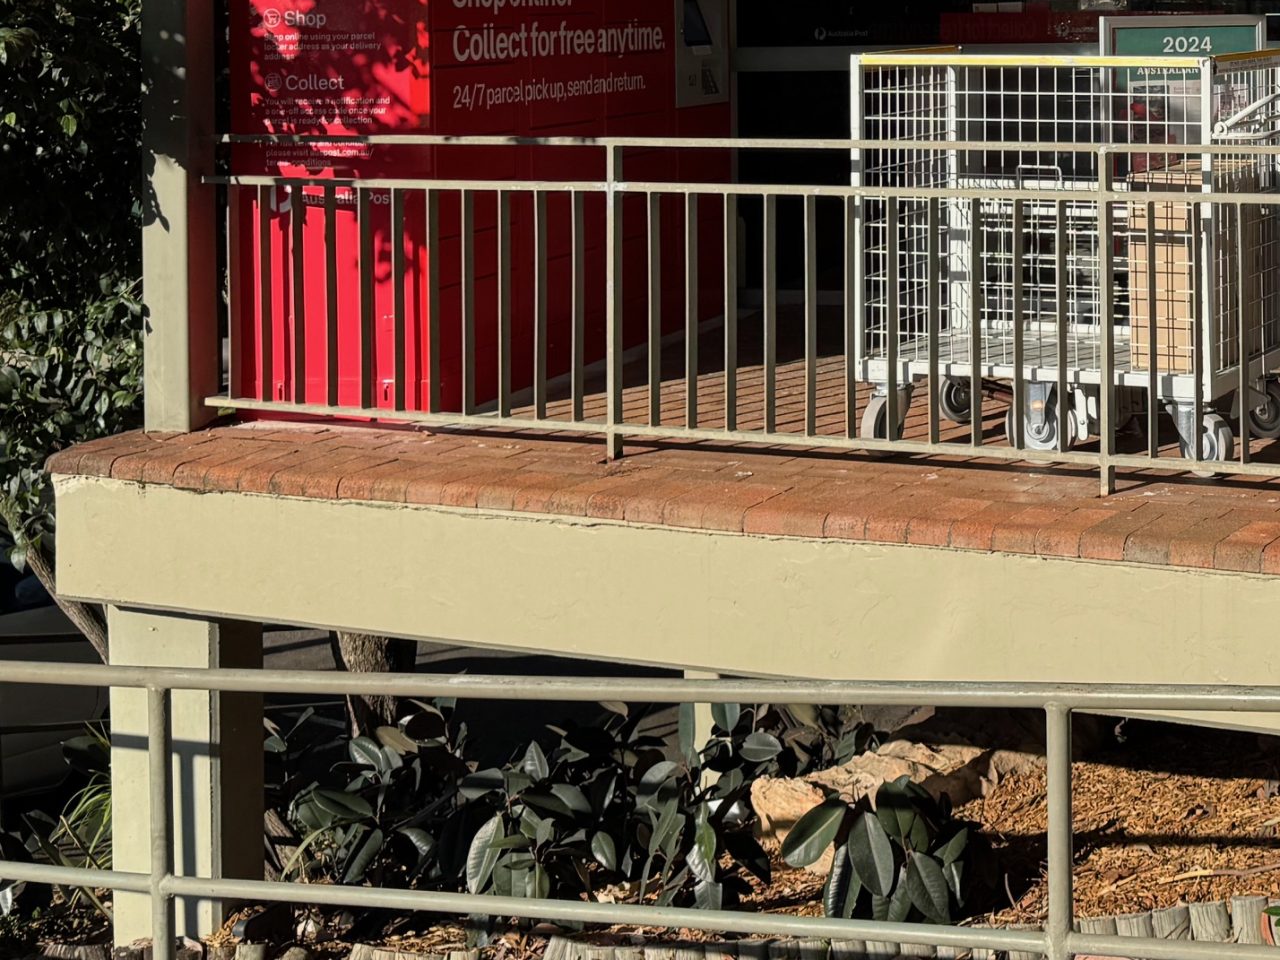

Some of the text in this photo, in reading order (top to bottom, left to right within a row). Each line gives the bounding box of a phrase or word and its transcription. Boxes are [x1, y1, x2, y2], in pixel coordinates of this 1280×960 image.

[284, 10, 327, 29] Shop
[284, 32, 308, 41] online
[310, 32, 331, 43] using
[332, 33, 349, 43] your
[350, 32, 375, 42] parcel
[453, 18, 666, 62] Collect for free anytime.
[1163, 35, 1212, 53] 2024
[331, 43, 349, 52] your
[350, 41, 381, 51] delivery
[1137, 67, 1199, 76] AUSTRALAN
[285, 74, 345, 91] Collect
[453, 71, 646, 111] 24/7 parcel pick up, send and return.
[376, 95, 390, 105] and
[348, 106, 368, 114] once
[369, 106, 387, 117] your
